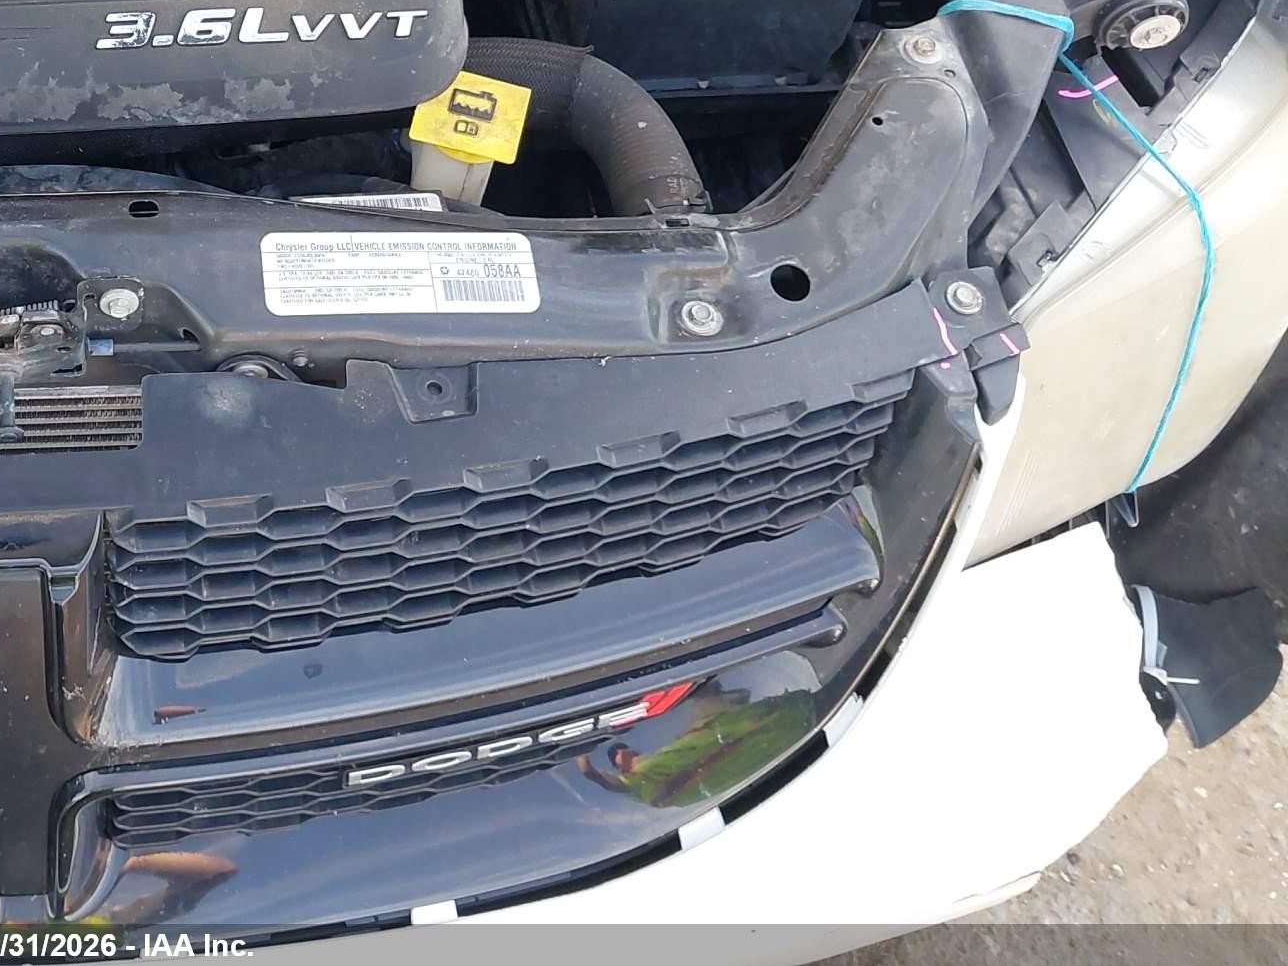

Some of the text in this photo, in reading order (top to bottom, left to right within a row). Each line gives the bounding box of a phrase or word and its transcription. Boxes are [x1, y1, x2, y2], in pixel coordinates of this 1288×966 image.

[95, 7, 428, 49] 3.6L VVT
[275, 242, 517, 253] Chrysler Group LLC VEHICLE EMISSION CONTROL INFORMATION
[347, 701, 651, 786] DODGE
